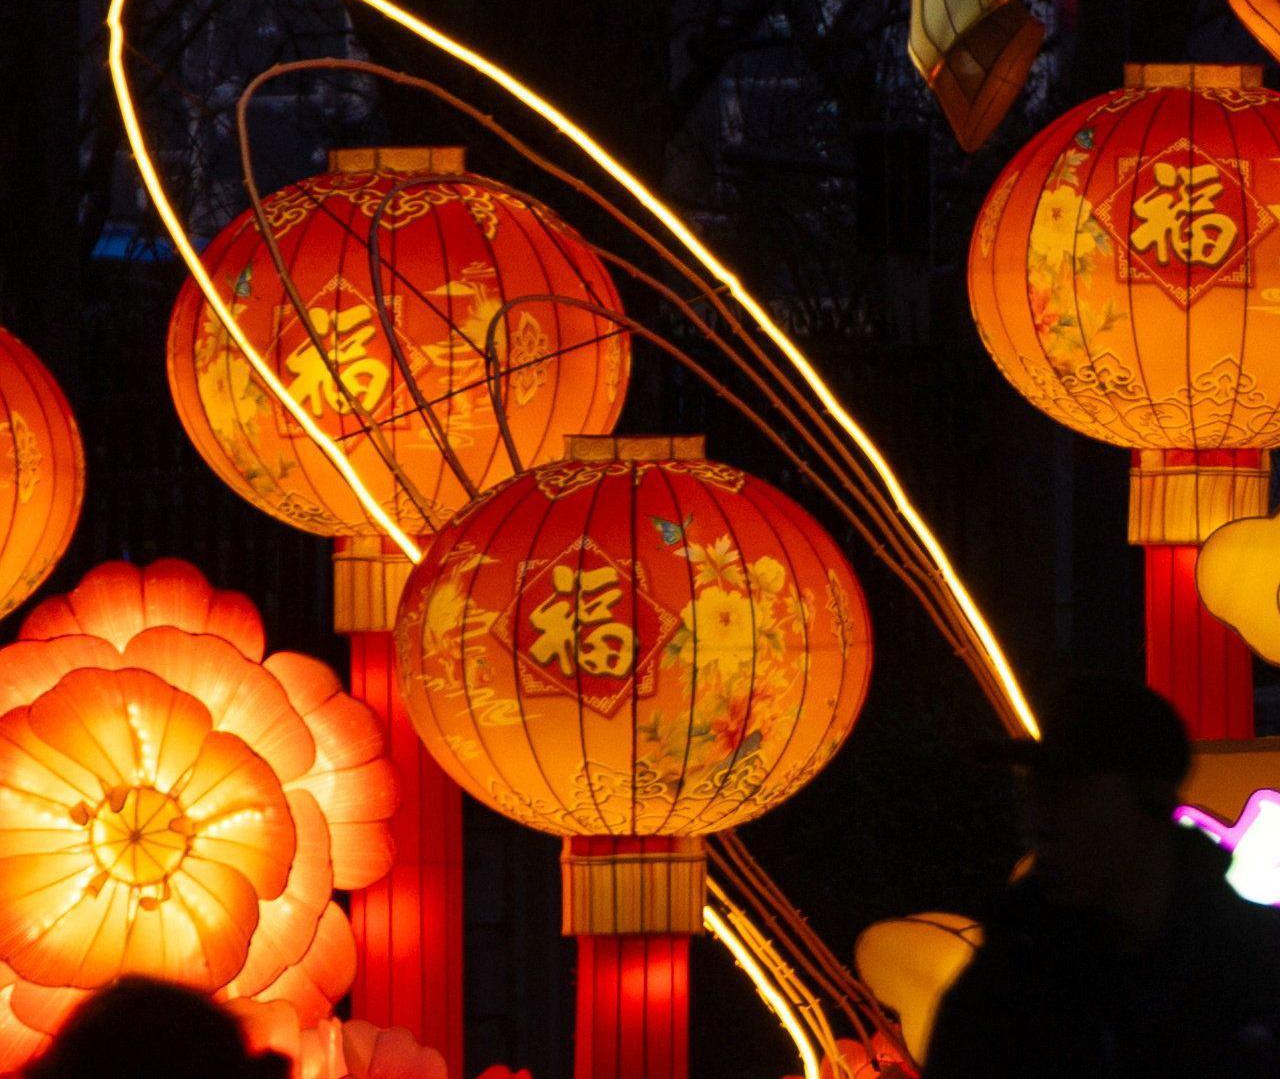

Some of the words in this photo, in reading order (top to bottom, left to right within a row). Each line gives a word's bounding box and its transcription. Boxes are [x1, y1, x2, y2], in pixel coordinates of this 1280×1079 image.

[1130, 162, 1238, 266] 福
[285, 304, 390, 417] 福
[529, 565, 634, 677] 福
